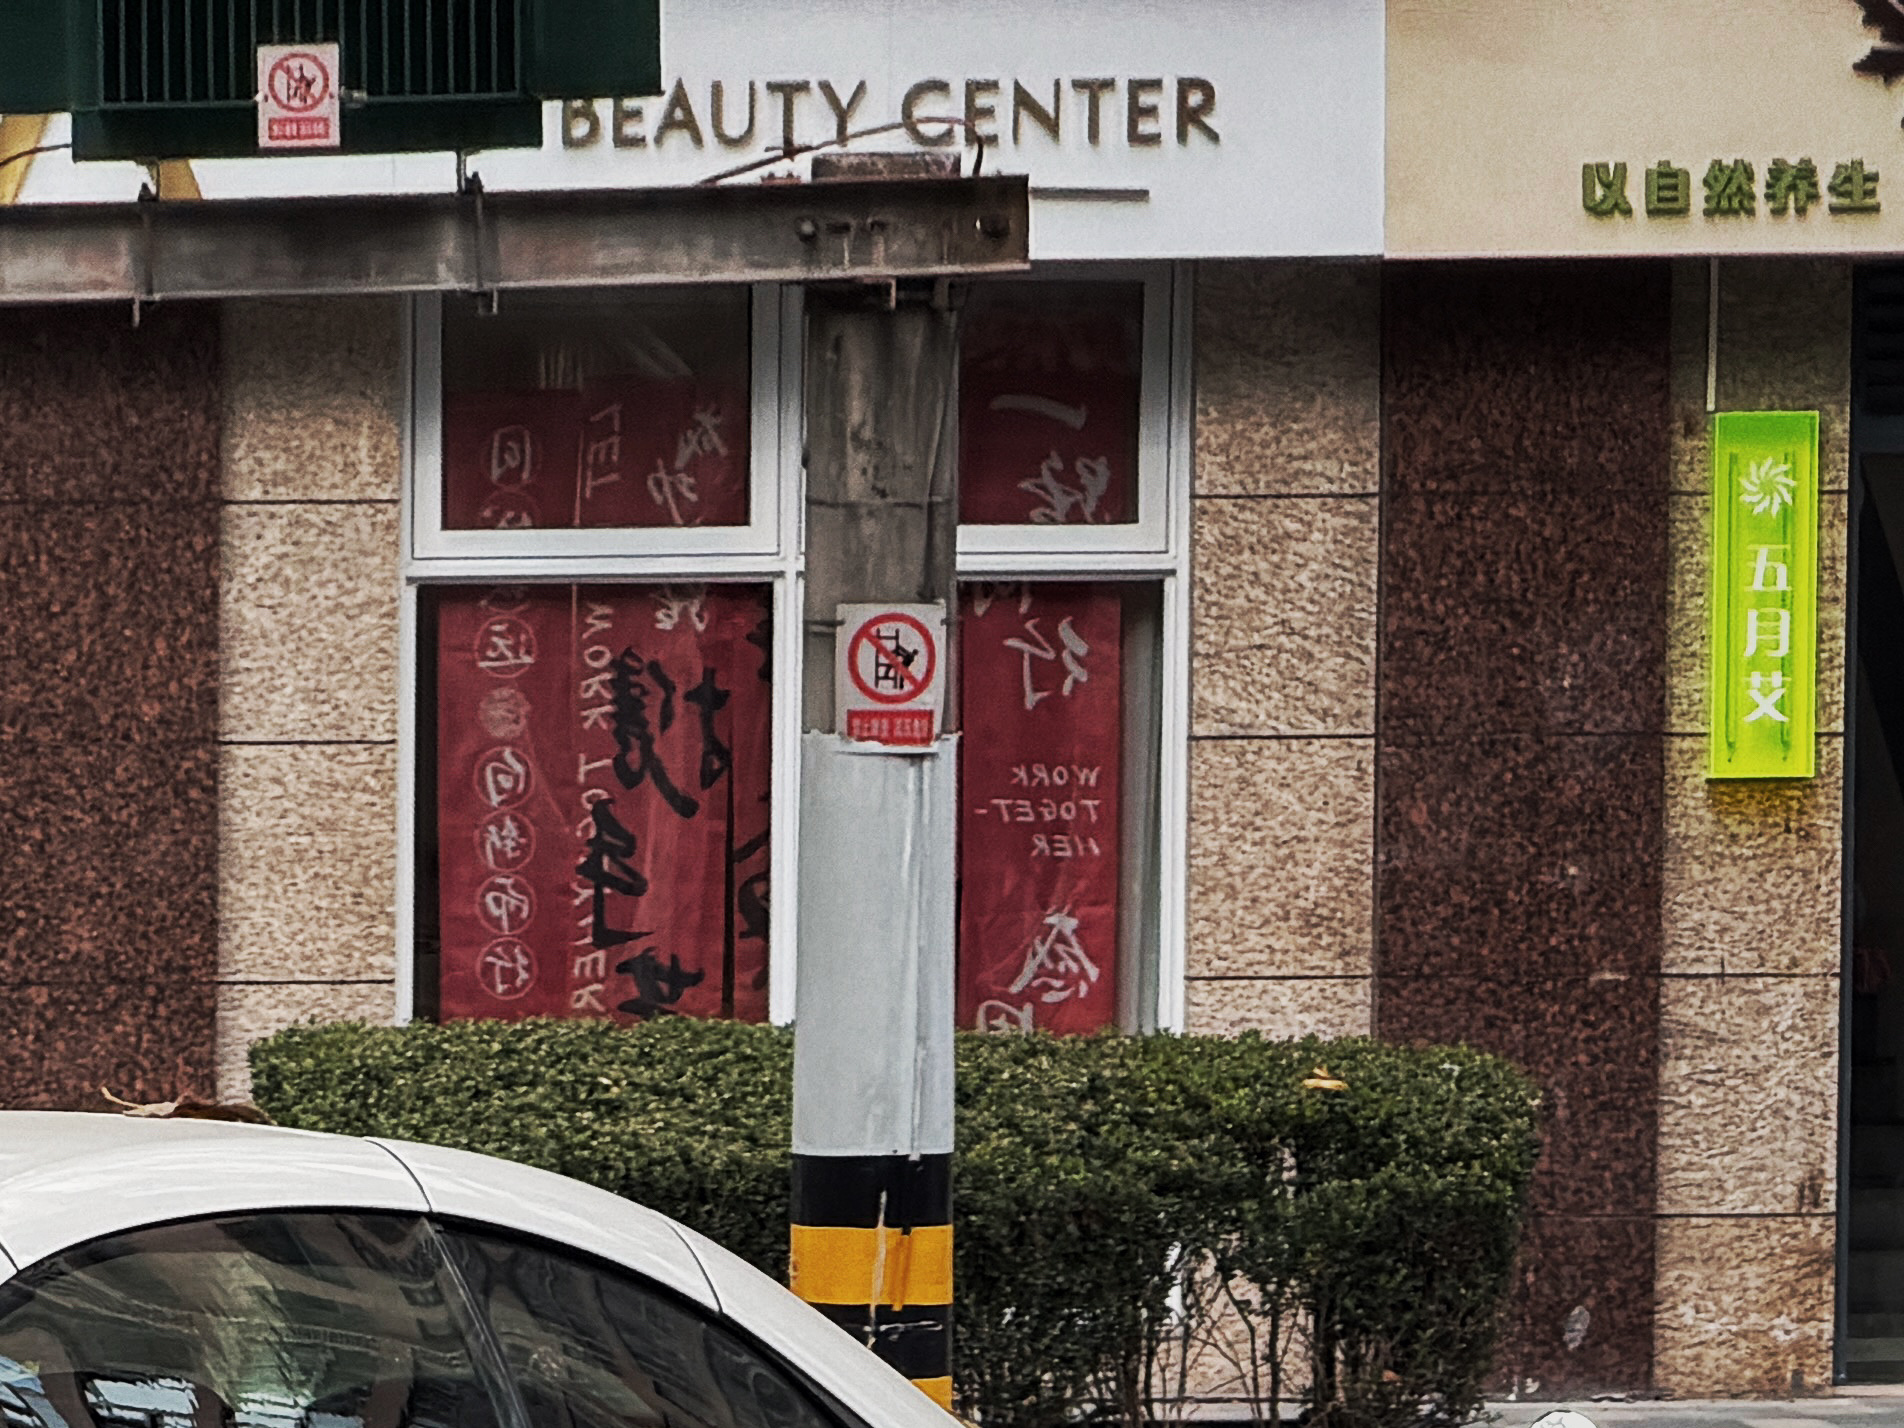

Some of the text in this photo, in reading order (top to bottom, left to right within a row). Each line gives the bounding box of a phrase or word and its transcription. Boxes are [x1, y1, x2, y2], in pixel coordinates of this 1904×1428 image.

[561, 77, 1222, 149] BEAUTY CENTER
[1582, 157, 1882, 217] 以自然养生
[1743, 543, 1792, 723] 五月艾
